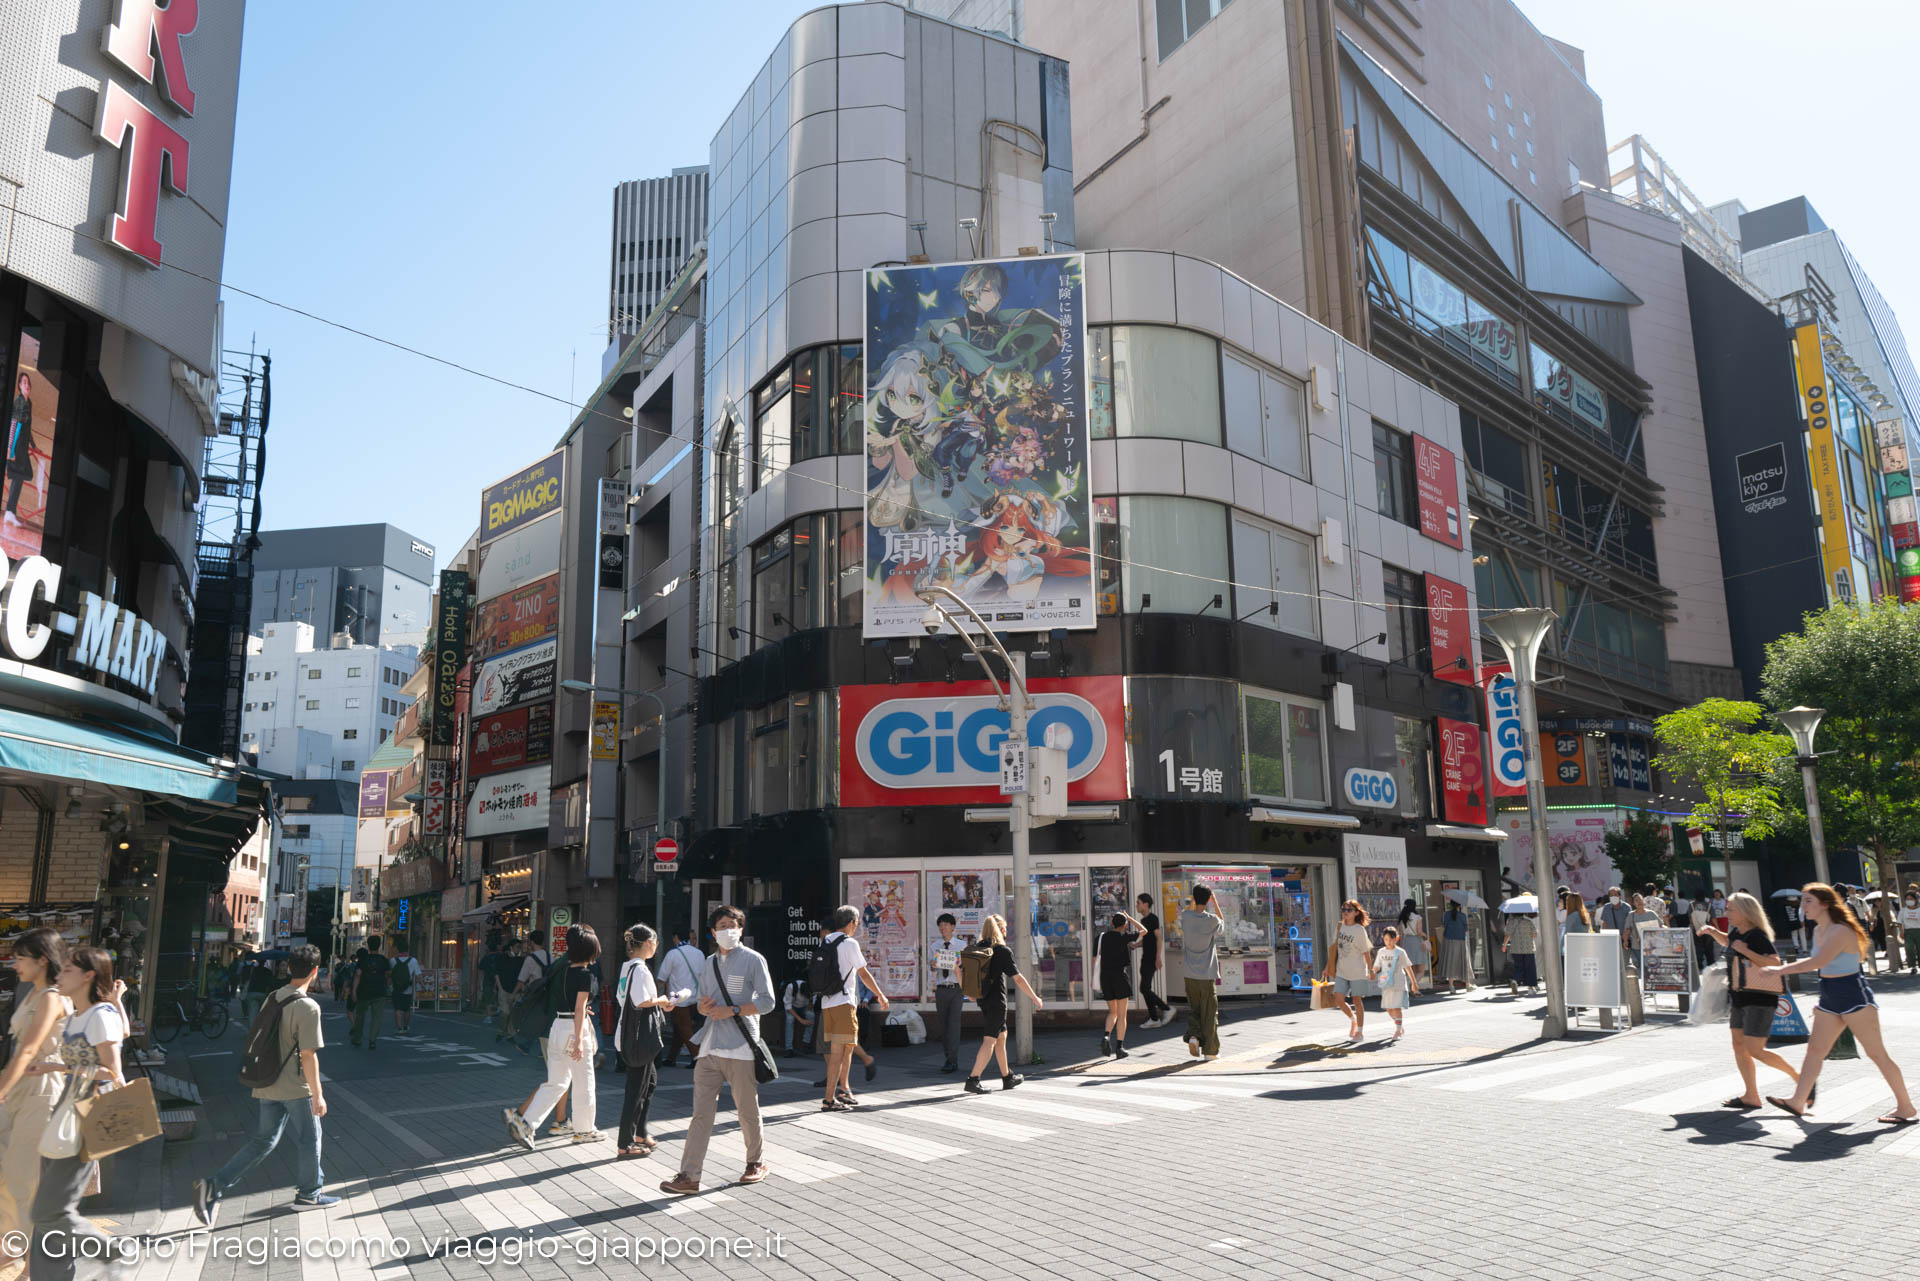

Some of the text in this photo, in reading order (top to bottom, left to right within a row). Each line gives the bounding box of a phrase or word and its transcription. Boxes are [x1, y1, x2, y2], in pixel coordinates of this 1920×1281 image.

[1058, 273, 1078, 503] 冒険に満ちたブランニューワールドへ
[1419, 443, 1441, 480] 4F
[1742, 466, 1783, 485] matsu
[488, 476, 559, 531] BIGMAGIC
[604, 493, 625, 505] VIOLIN
[1744, 482, 1768, 499] kiyo
[504, 552, 531, 574] sand
[880, 518, 967, 580] 原神
[888, 567, 939, 576] Genshin
[514, 593, 542, 622] ZINO
[1429, 585, 1453, 623] 3F
[0, 546, 167, 696] C-MART
[444, 606, 459, 643] Hotel
[1433, 637, 1448, 649] GAME
[869, 704, 1093, 777] GiGO
[1442, 729, 1465, 767] 2F
[1557, 740, 1577, 752] 2F
[1159, 749, 1224, 794] 1号館
[1445, 768, 1462, 781] CRANE
[1560, 766, 1579, 778] 3F
[1350, 772, 1396, 804] GiGO
[1446, 782, 1461, 792] GAME
[427, 780, 445, 832] ラーメン
[398, 898, 409, 930] HOTEL
[787, 906, 803, 918] Get
[789, 920, 808, 931] into
[787, 948, 813, 960] Oasis
